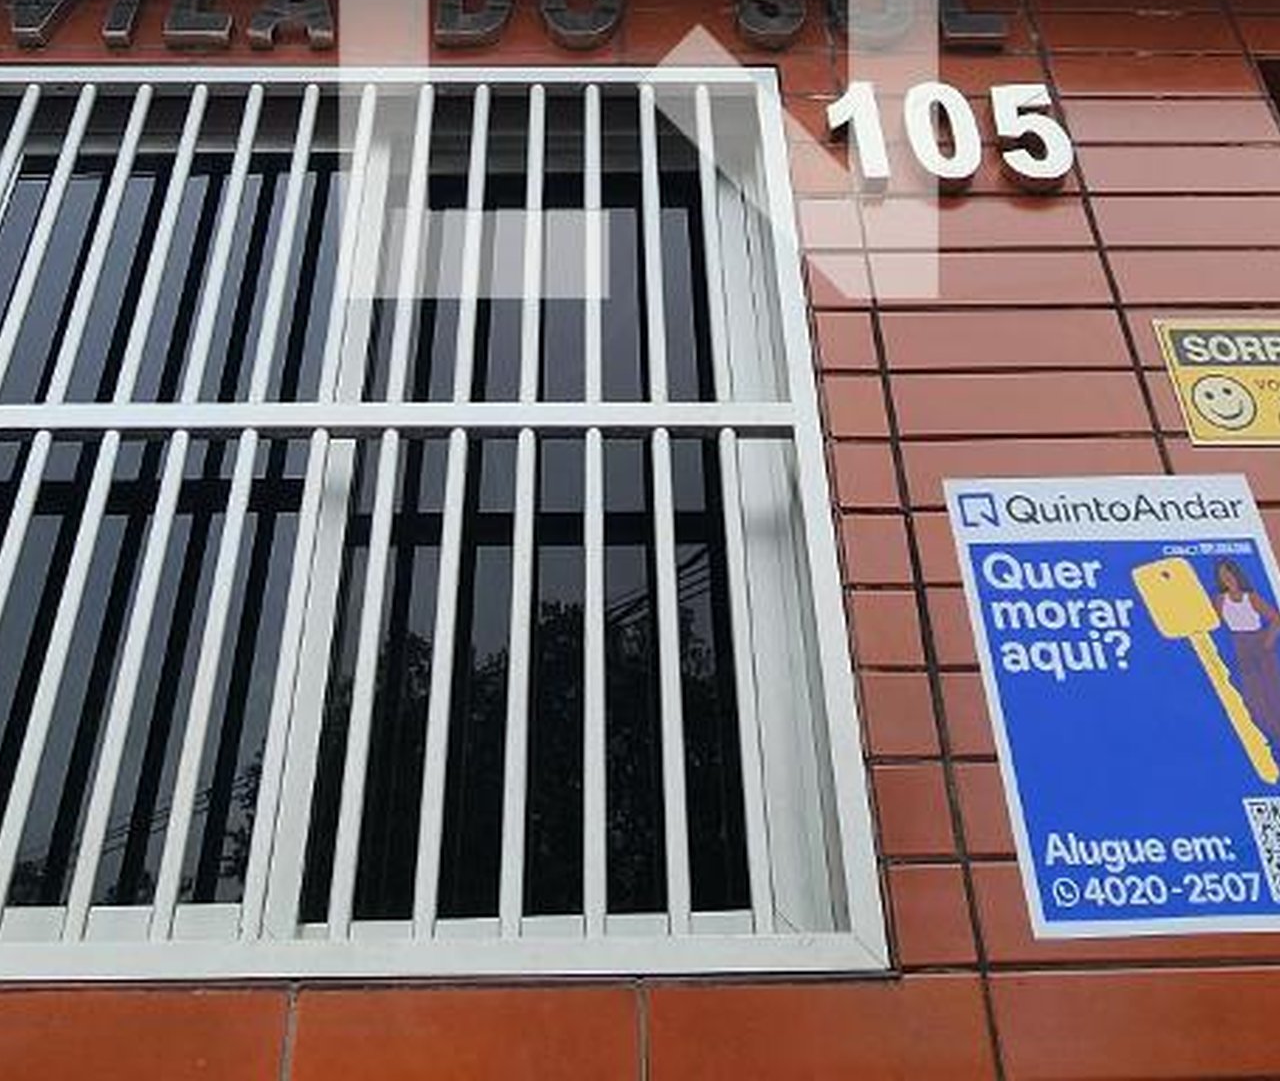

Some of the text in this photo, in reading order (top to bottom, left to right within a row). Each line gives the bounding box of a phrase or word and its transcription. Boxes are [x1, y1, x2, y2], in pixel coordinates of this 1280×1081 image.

[826, 80, 1075, 191] 105
[1005, 492, 1244, 525] QuintoAndar
[982, 552, 1102, 591] Quer
[991, 599, 1134, 630] morar
[1001, 631, 1132, 682] aqui?
[1046, 832, 1237, 874] Alugue em:
[1083, 872, 1261, 906] 4020-2507
